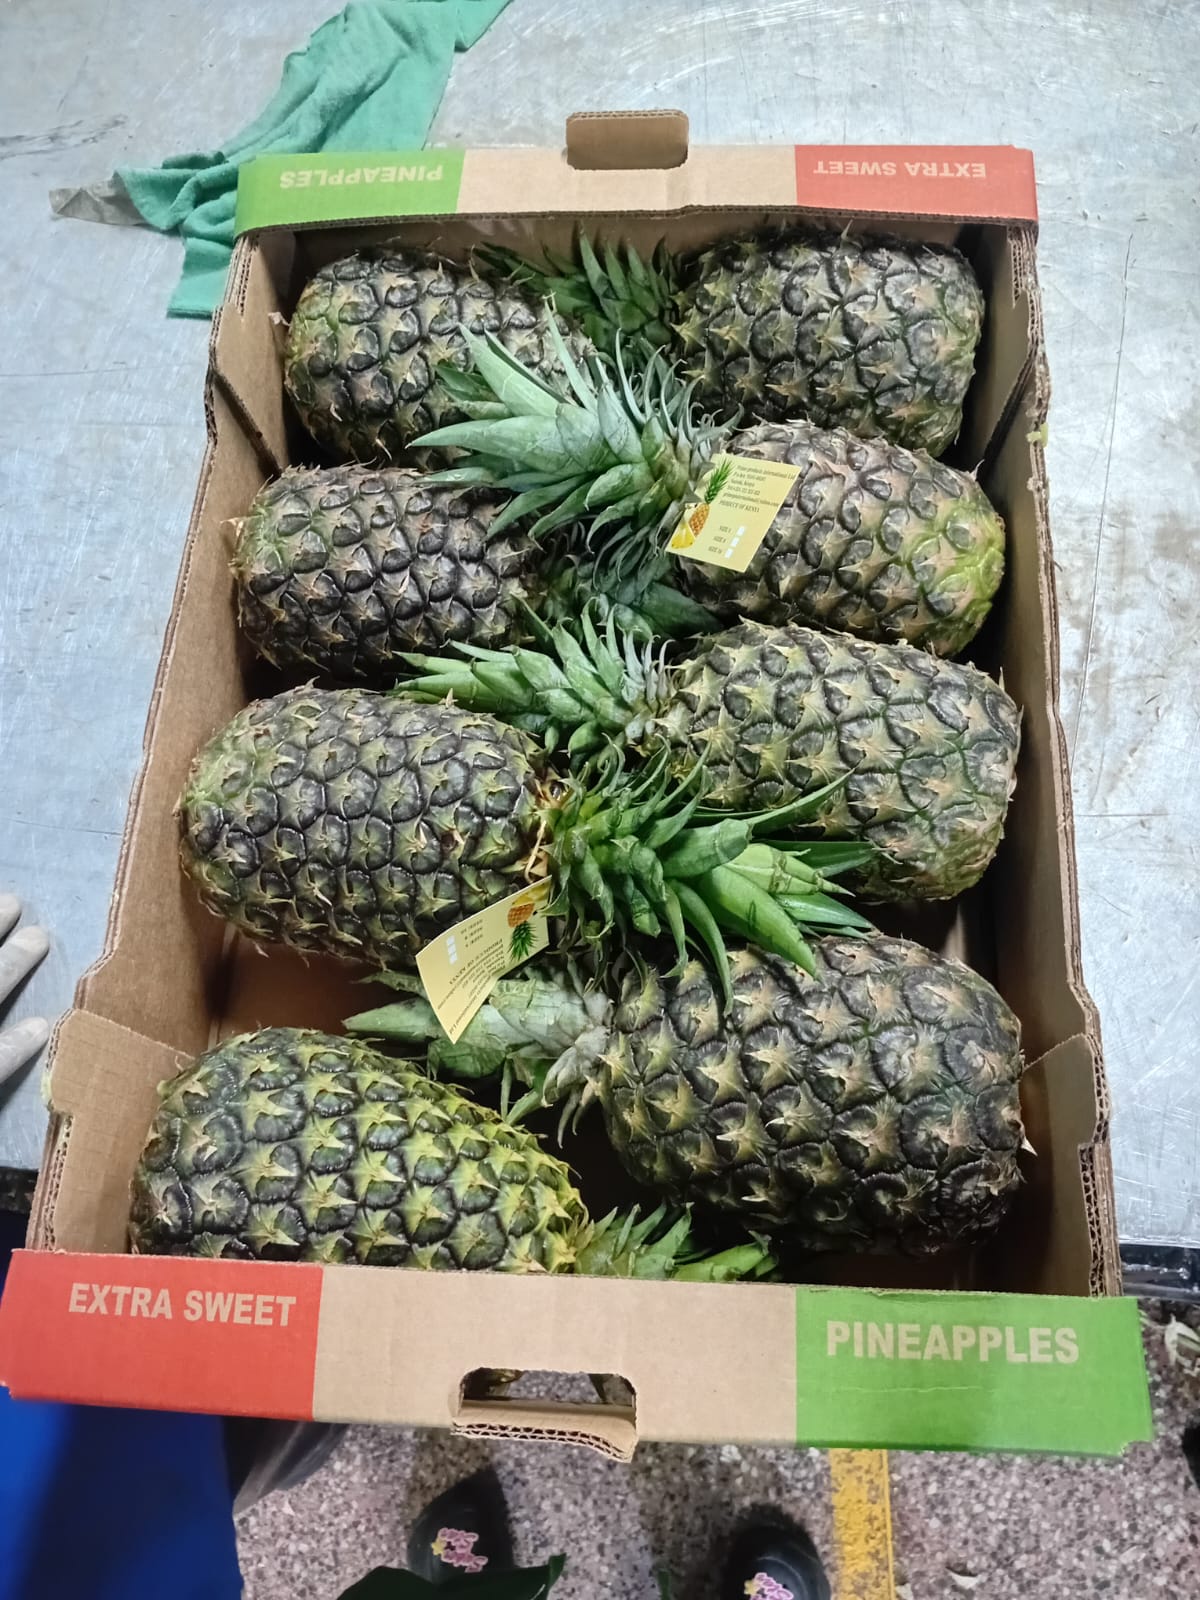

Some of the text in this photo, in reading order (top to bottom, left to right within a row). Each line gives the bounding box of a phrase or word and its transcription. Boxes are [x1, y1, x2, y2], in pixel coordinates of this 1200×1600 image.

[280, 165, 443, 188] PINEAPPLES
[813, 160, 986, 178] EXTRA SWEET
[68, 1282, 297, 1326] EXTRA SWEET
[826, 1320, 1080, 1364] PINEAPPLES
